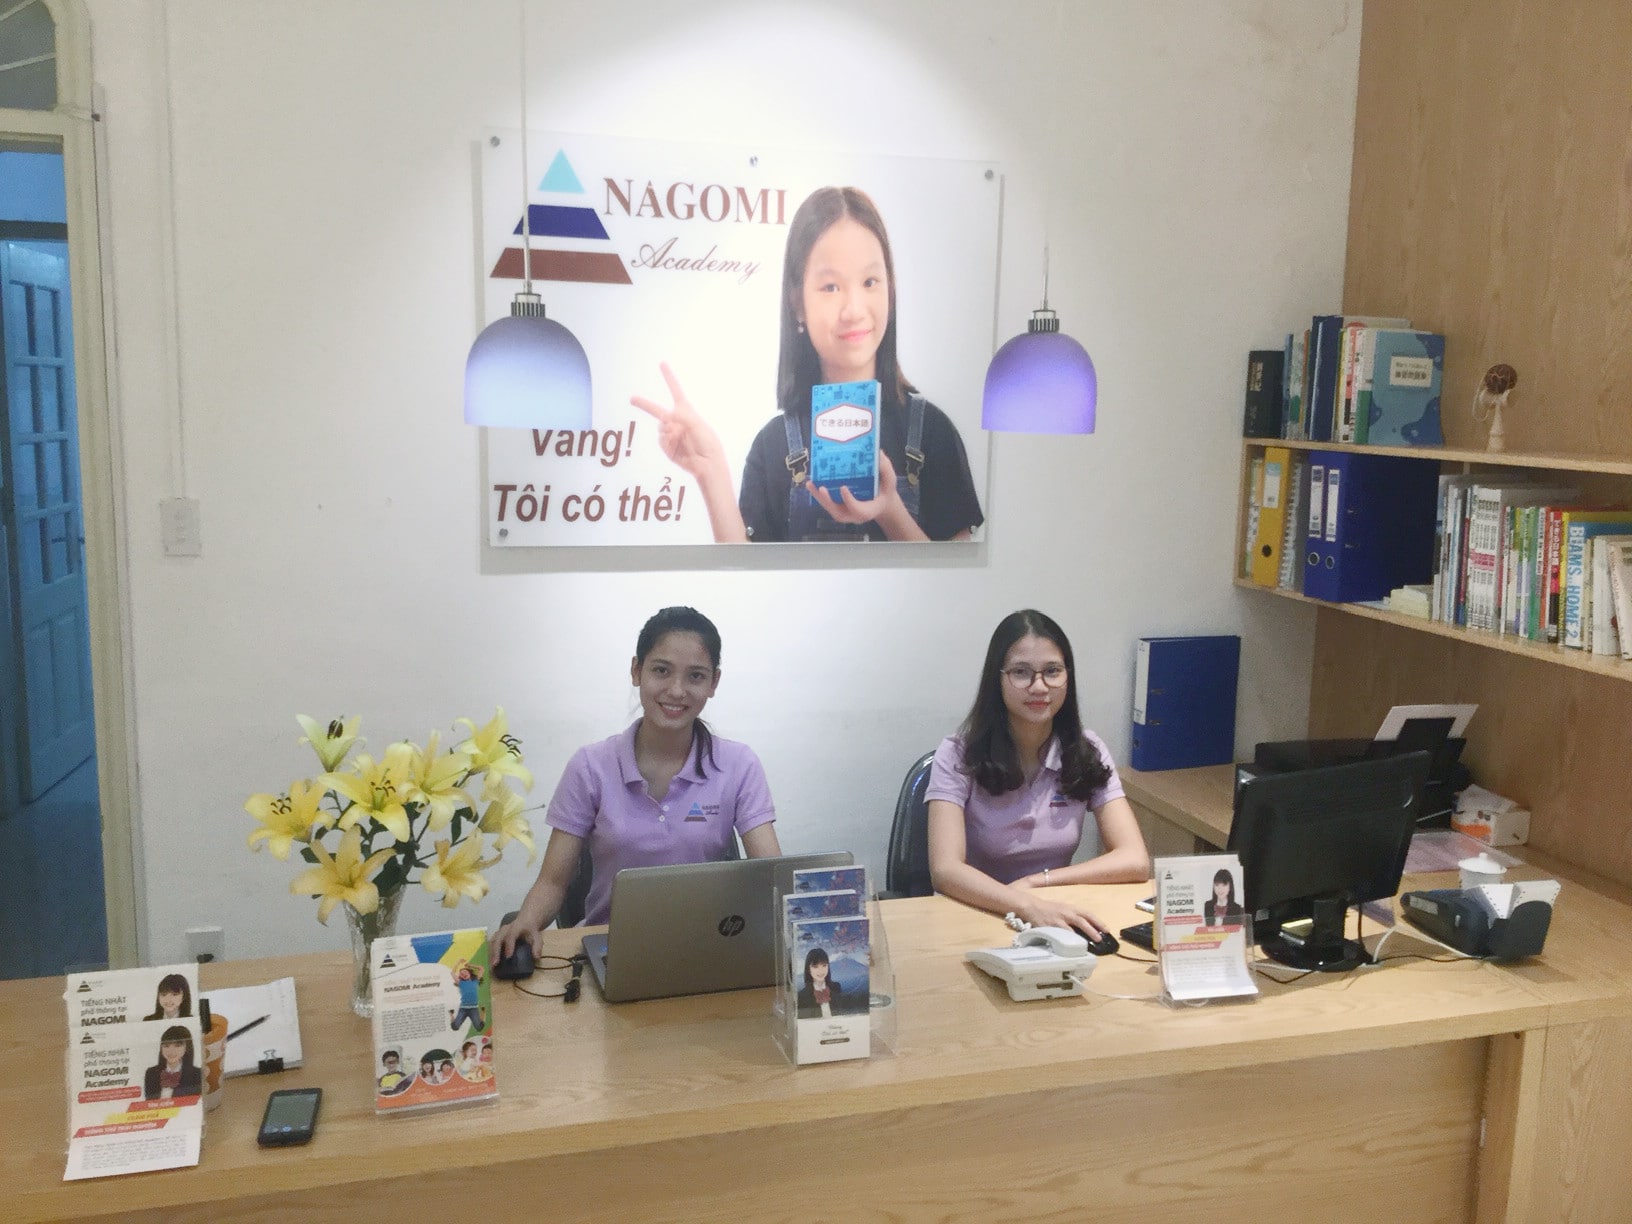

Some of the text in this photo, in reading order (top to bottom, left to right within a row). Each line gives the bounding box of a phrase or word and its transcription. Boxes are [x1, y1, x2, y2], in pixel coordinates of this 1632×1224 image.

[603, 177, 787, 225] NAGOMI
[631, 236, 761, 286] Academy
[493, 476, 686, 523] Tôi có thể!
[1564, 526, 1585, 639] BEAMS HOME 2
[718, 914, 746, 937] hp
[81, 1015, 126, 1027] NAGOMI
[84, 1066, 129, 1078] NAGOMI
[85, 1078, 130, 1088] Academy
